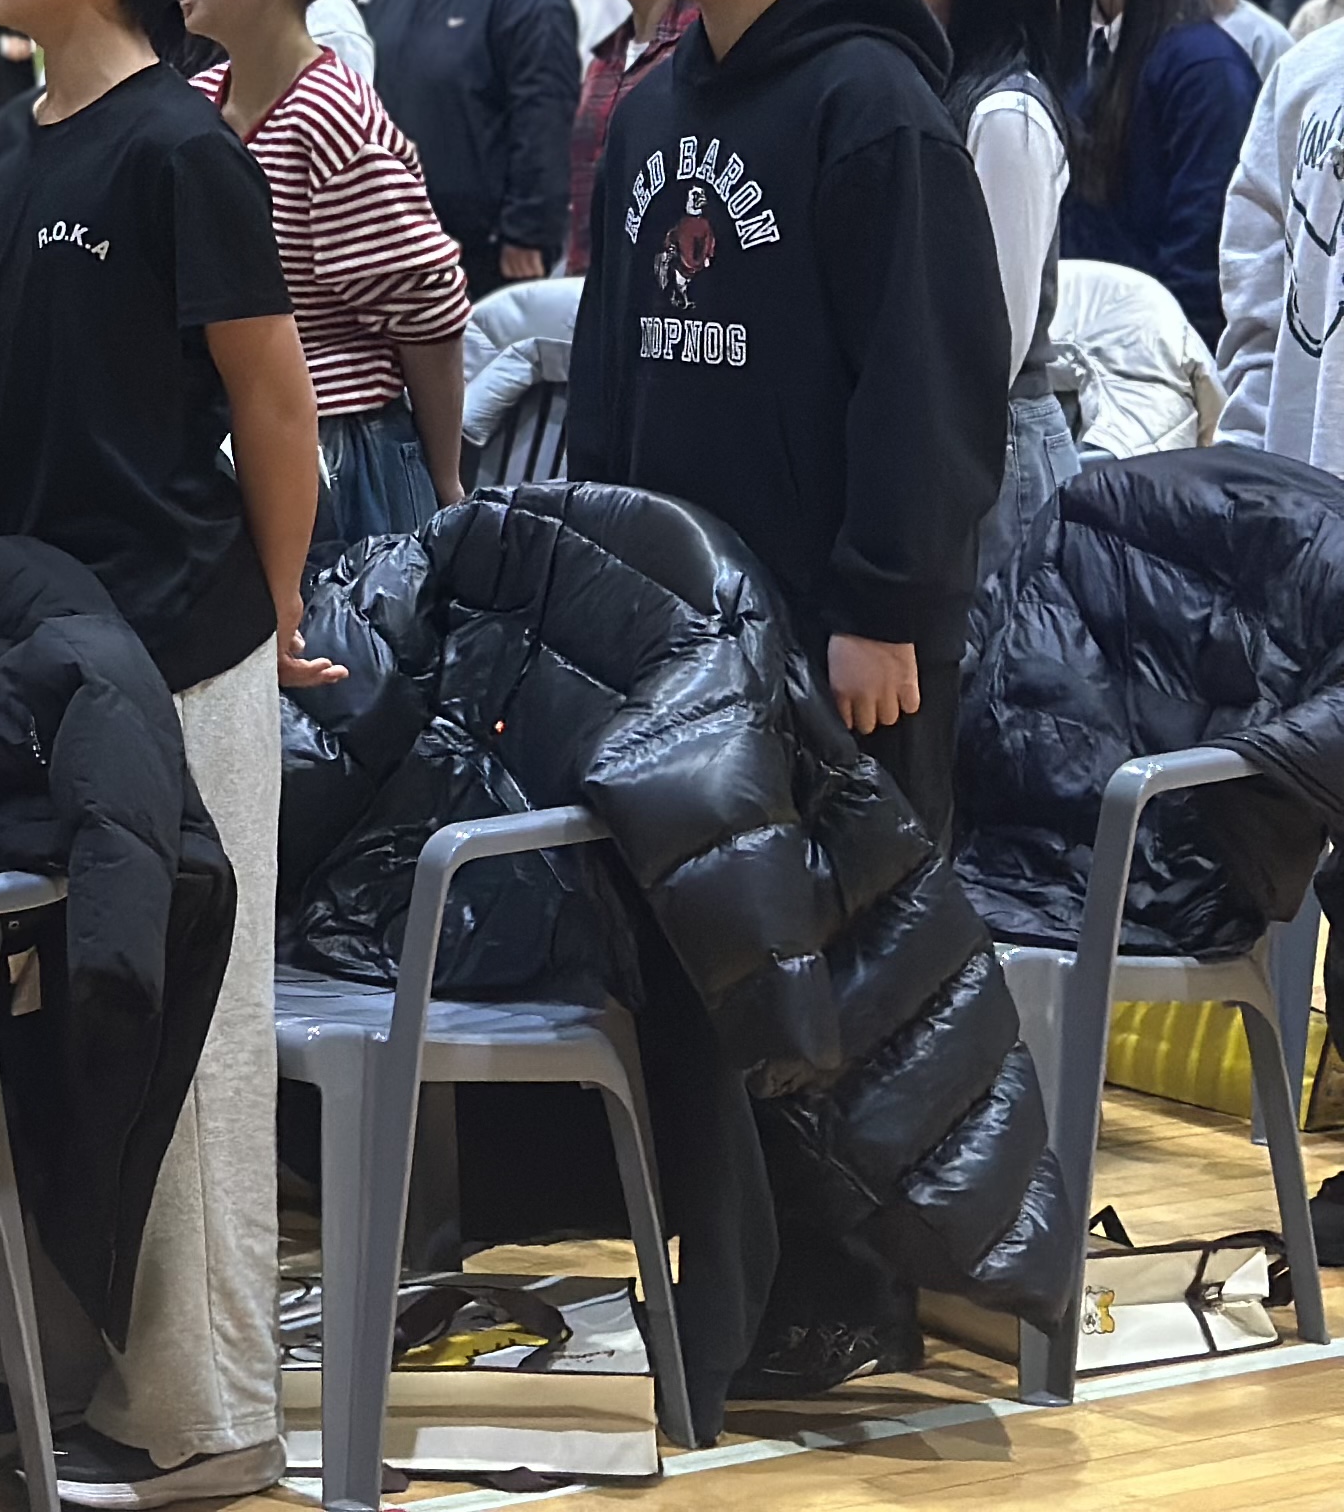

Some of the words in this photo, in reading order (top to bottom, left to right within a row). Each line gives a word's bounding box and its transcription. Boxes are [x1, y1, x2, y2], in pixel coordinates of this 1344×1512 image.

[625, 150, 665, 244] RED
[677, 136, 781, 250] BARON
[38, 220, 110, 260] R.O.K.A
